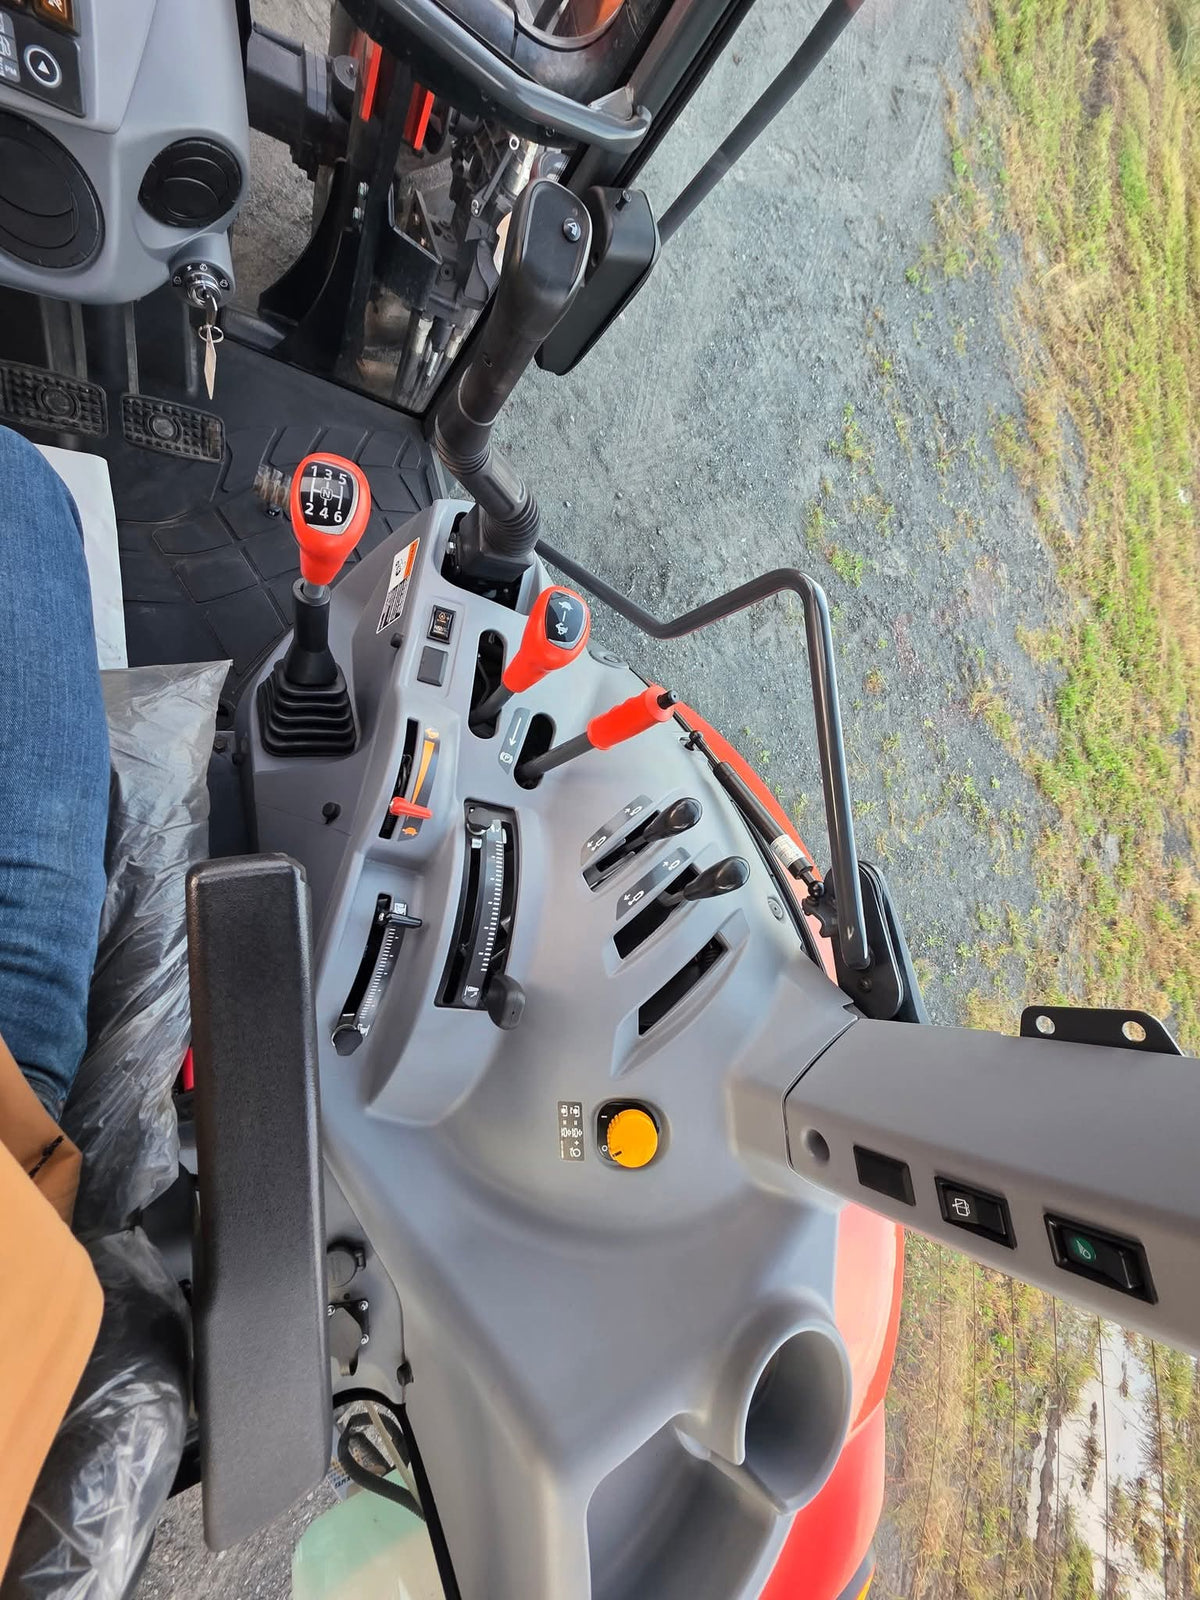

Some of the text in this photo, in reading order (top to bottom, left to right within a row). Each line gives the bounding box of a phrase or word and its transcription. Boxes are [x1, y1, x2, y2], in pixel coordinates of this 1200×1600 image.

[310, 465, 347, 485] 1 3 5
[322, 489, 331, 498] N
[304, 502, 343, 523] 2 4 6
